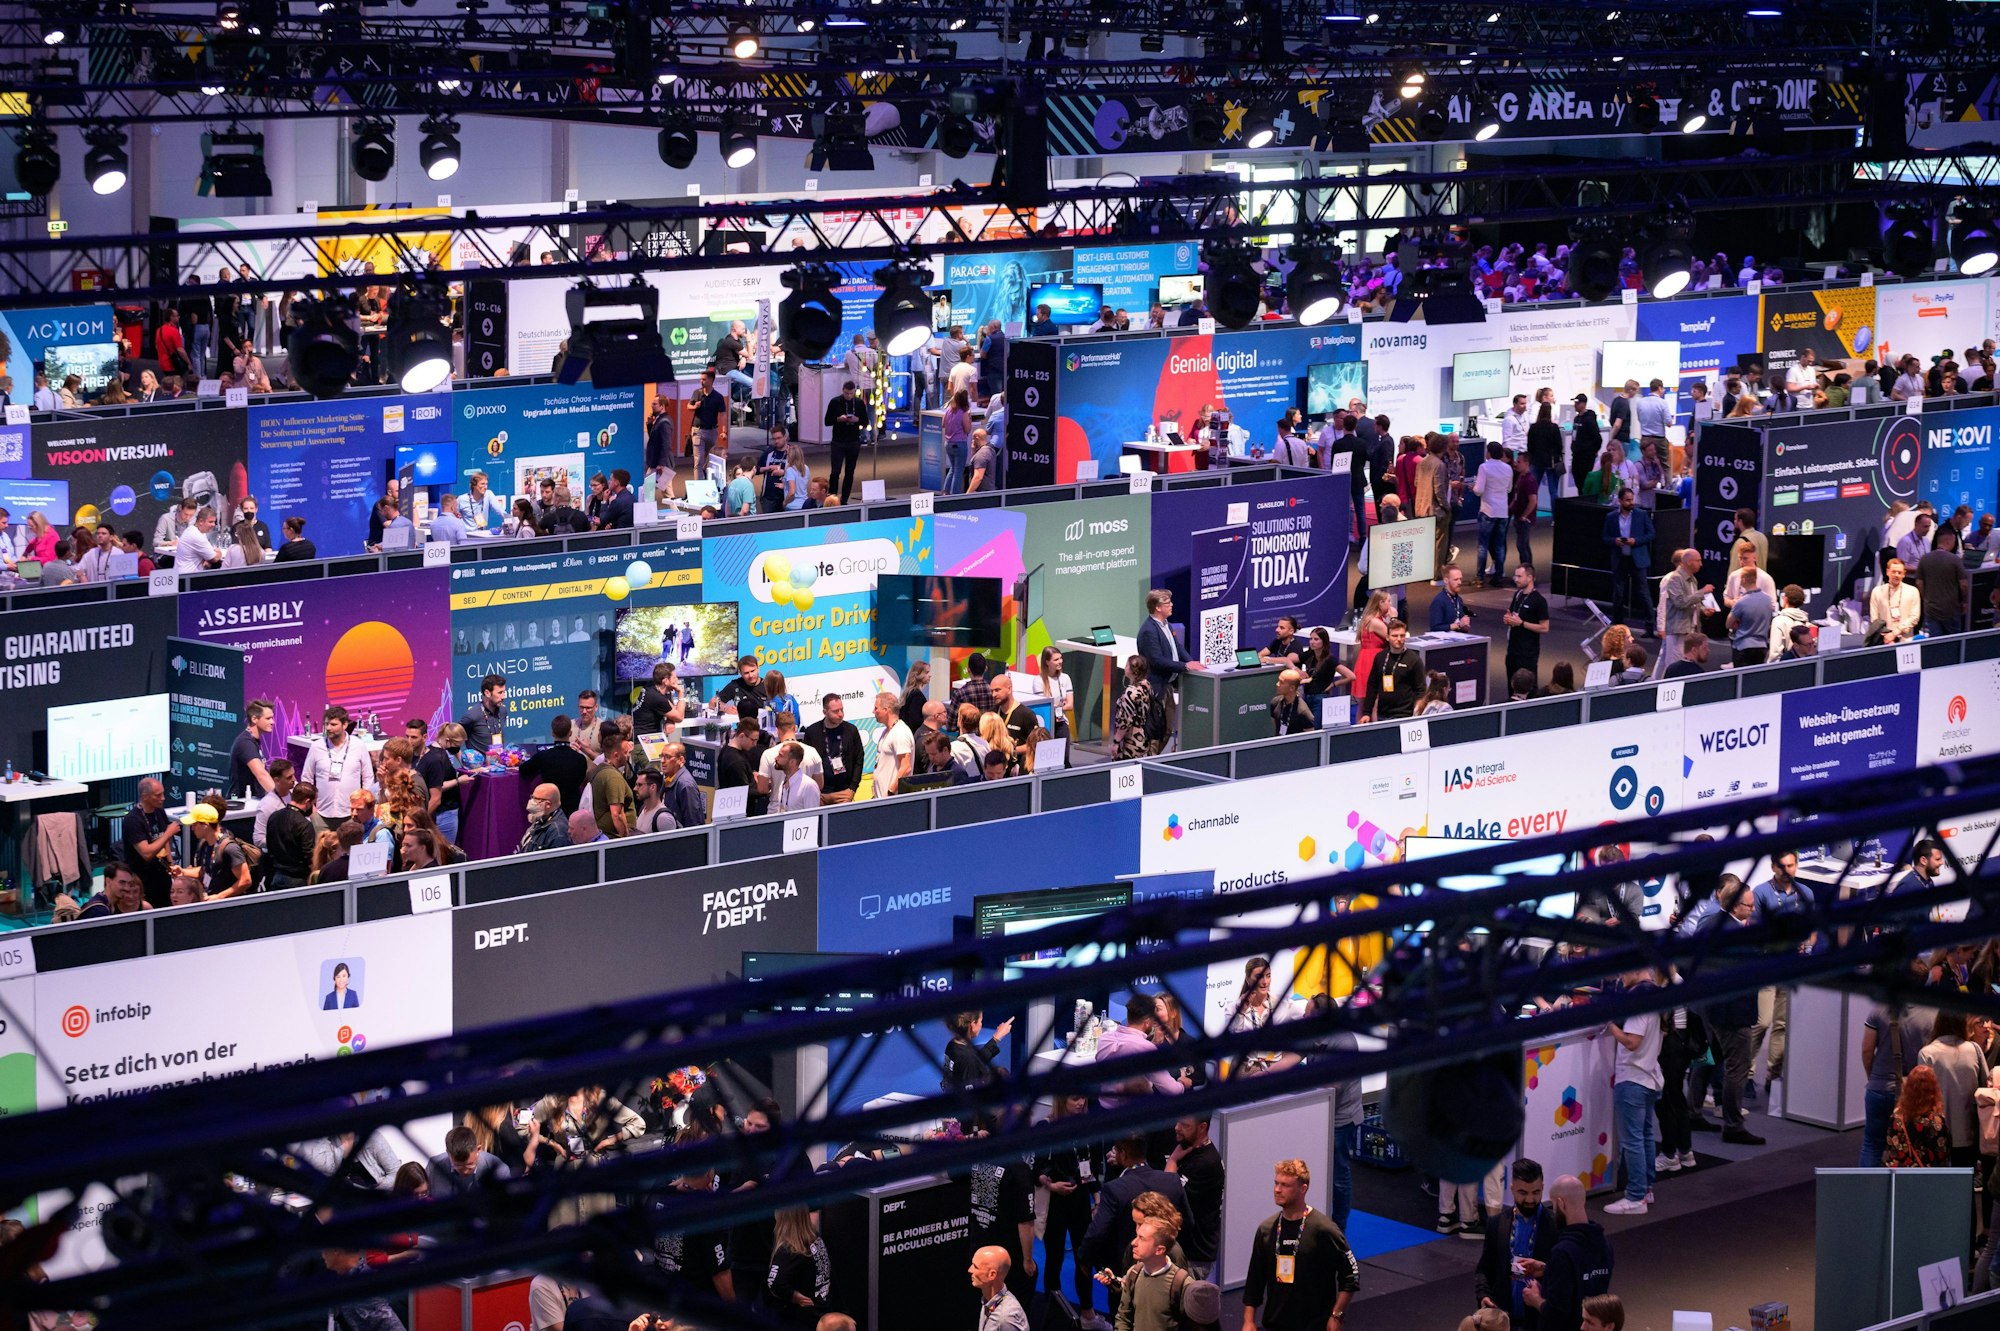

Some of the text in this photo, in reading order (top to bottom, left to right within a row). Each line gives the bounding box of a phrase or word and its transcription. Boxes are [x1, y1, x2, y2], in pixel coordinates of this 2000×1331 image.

[1527, 91, 1594, 121] AREA
[648, 231, 686, 239] CUSTOMER
[648, 239, 690, 249] EXPERIENCE
[1078, 250, 1149, 262] NEXT-LEVEL CUSTOMER
[1077, 262, 1149, 273] ENGAGEMENT THROUGH
[743, 278, 761, 286] SERV
[1115, 273, 1153, 282] AUTOMATION
[1785, 312, 1817, 322] BINANCE
[27, 320, 104, 340] ACXIOM
[1370, 334, 1427, 349] novamag
[1768, 350, 1796, 360] CONNECT.
[1170, 350, 1257, 374] Genial digital
[1768, 361, 1784, 370] MEET.
[1014, 369, 1050, 381] E14 E25
[1463, 368, 1501, 378] novamag.de
[1523, 366, 1555, 375] ALLVEST
[229, 392, 243, 402] E11
[571, 396, 591, 404] Chaos
[10, 409, 26, 418] E10
[411, 407, 442, 420] IROIN
[523, 409, 551, 418] Upgrade
[569, 406, 589, 414] Media
[591, 402, 634, 412] Management
[284, 417, 315, 426] Influencer
[317, 415, 348, 424] Marketing
[261, 440, 292, 449] Steuerung
[307, 437, 345, 445] Auswertung
[1928, 425, 1991, 449] NEXOVI
[47, 443, 173, 466] VISOONIVERSUM.
[1012, 452, 1050, 465] D14 D25
[1335, 457, 1348, 467] G13
[1704, 455, 1755, 471] G14 G25
[1774, 459, 1879, 478] Einfach. Leistungsstark. Sicher.
[1133, 477, 1148, 488] G12
[914, 500, 930, 510] G11
[680, 523, 698, 533] G10
[1089, 519, 1128, 536] moss
[1252, 515, 1312, 535] SOLUTIONS FOR
[1391, 529, 1405, 538] ARE
[1251, 531, 1311, 556] TOMORROW.
[428, 548, 445, 558] G09
[598, 555, 618, 563] BOSCH
[642, 550, 665, 558] eventim
[1059, 545, 1134, 562] The all-in-one spend
[1704, 550, 1721, 561] F14
[839, 557, 887, 575] Group
[1056, 558, 1137, 576] management platform
[1251, 551, 1309, 589] TODAY.
[153, 576, 173, 587] G08
[502, 591, 532, 600] CONTENT
[559, 584, 593, 595] DIGITAL PR
[463, 596, 477, 604] SEO
[750, 613, 825, 636] Creator
[5, 623, 134, 660] GUARANTEED
[252, 636, 303, 649] omnichannel
[754, 637, 812, 666] Social
[1903, 654, 1915, 665] I11
[189, 661, 226, 679] BLUEOAK
[467, 658, 528, 679] CLANEO
[179, 694, 192, 704] DREI
[193, 697, 226, 711] SCHRITTEN
[1663, 690, 1676, 702] I10
[510, 696, 564, 711] & Content
[1248, 703, 1267, 714] moss
[191, 715, 213, 728] ERFOLG
[1799, 702, 1900, 729] Website-Übersetzung
[1408, 729, 1422, 743] I09
[1700, 723, 1769, 753] WEGLOT
[1814, 724, 1884, 747] leicht gemacht.
[1942, 726, 1971, 740] etracker
[694, 751, 706, 760] Wir
[1939, 742, 1973, 758] Analytics
[689, 759, 711, 770] suchen
[1476, 761, 1505, 774] Integral
[1812, 760, 1840, 770] translation
[692, 768, 708, 780] dich!
[1444, 766, 1473, 793] IAS
[1475, 772, 1517, 788] Ad Science
[1118, 774, 1134, 789] I08
[1697, 788, 1715, 799] BASF
[1188, 813, 1239, 830] channable
[1444, 809, 1567, 839] Make every
[1974, 819, 1997, 830] blocked
[791, 827, 809, 842] I07
[1220, 868, 1288, 894] products,
[420, 886, 441, 902] I06
[702, 879, 798, 912] FACTOR-A
[886, 887, 951, 912] AMOBEE
[716, 904, 767, 929] DEPT.
[474, 923, 529, 950] DEPT.
[1215, 980, 1233, 989] globe
[95, 1002, 151, 1024] infobip
[65, 1041, 237, 1085] Setz dich von der
[1551, 1126, 1585, 1140] channable
[883, 1201, 906, 1213] DEPT.
[883, 1216, 969, 1244] BE A PIONEER & WIN
[883, 1229, 969, 1256] AN OCULUS QUEST 2
